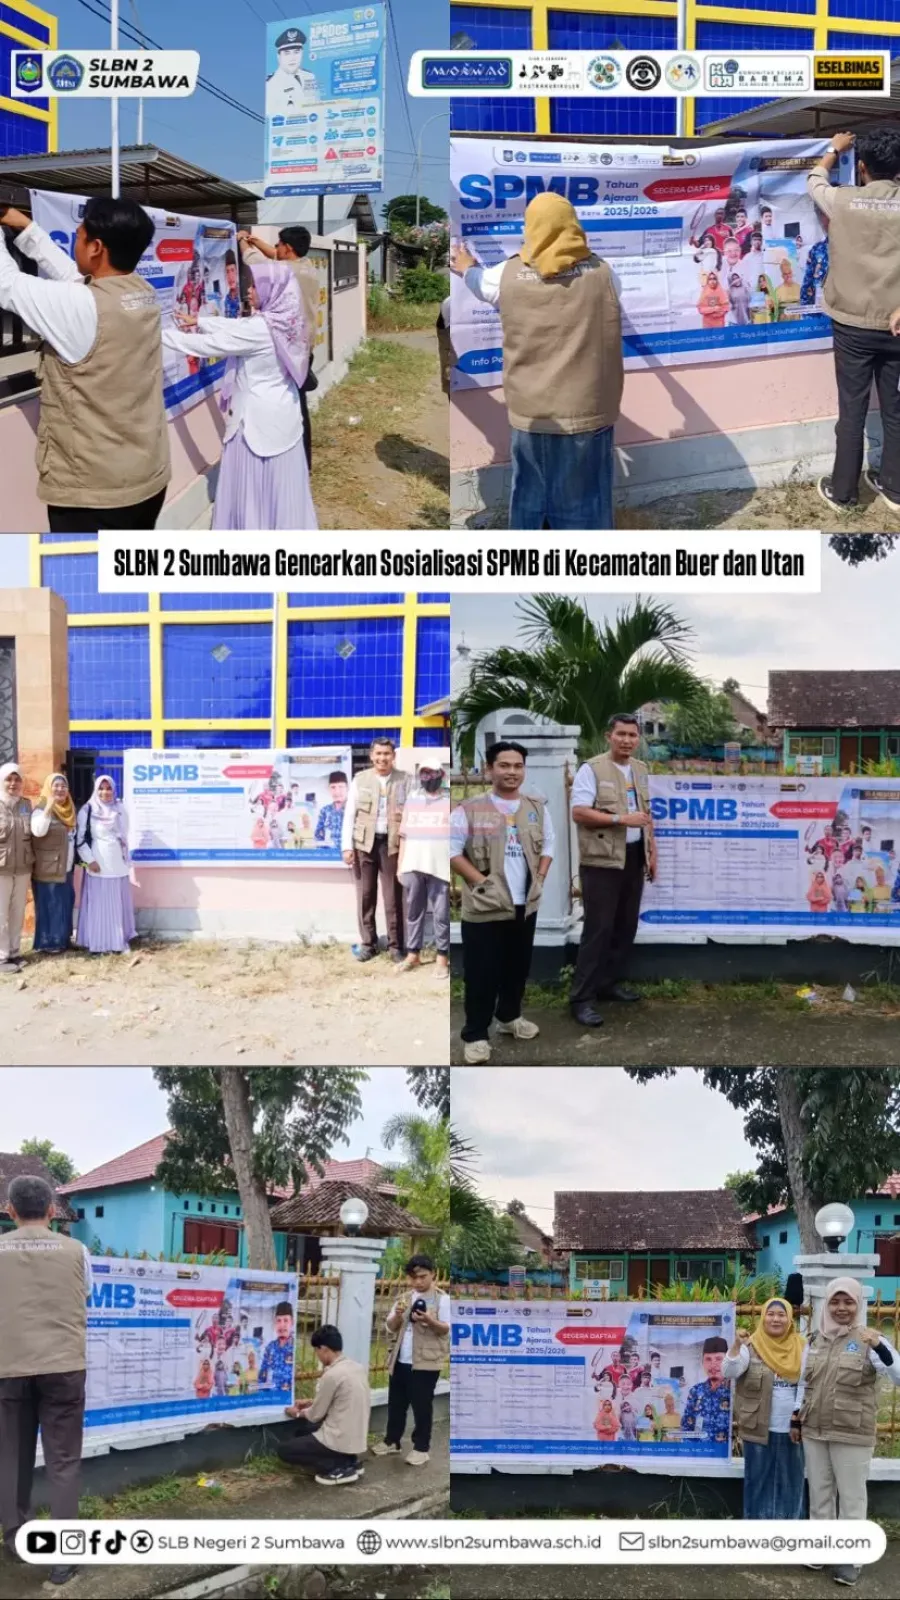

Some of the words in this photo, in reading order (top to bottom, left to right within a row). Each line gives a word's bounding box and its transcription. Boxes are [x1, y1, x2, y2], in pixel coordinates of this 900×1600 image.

[605, 180, 639, 189] Tahun
[652, 185, 686, 195] SEGERA
[686, 184, 721, 194] DAFTAR
[459, 173, 600, 210] SPMB
[603, 193, 639, 203] Ajaran
[603, 206, 659, 217] 2025/2026
[471, 356, 490, 367] Info
[132, 764, 199, 782] SPMB
[650, 797, 738, 821] SPMB
[87, 1283, 136, 1309] MB
[451, 1323, 523, 1347] PMB
[526, 1326, 551, 1334] Tahun
[525, 1347, 566, 1355] 2025/2026
